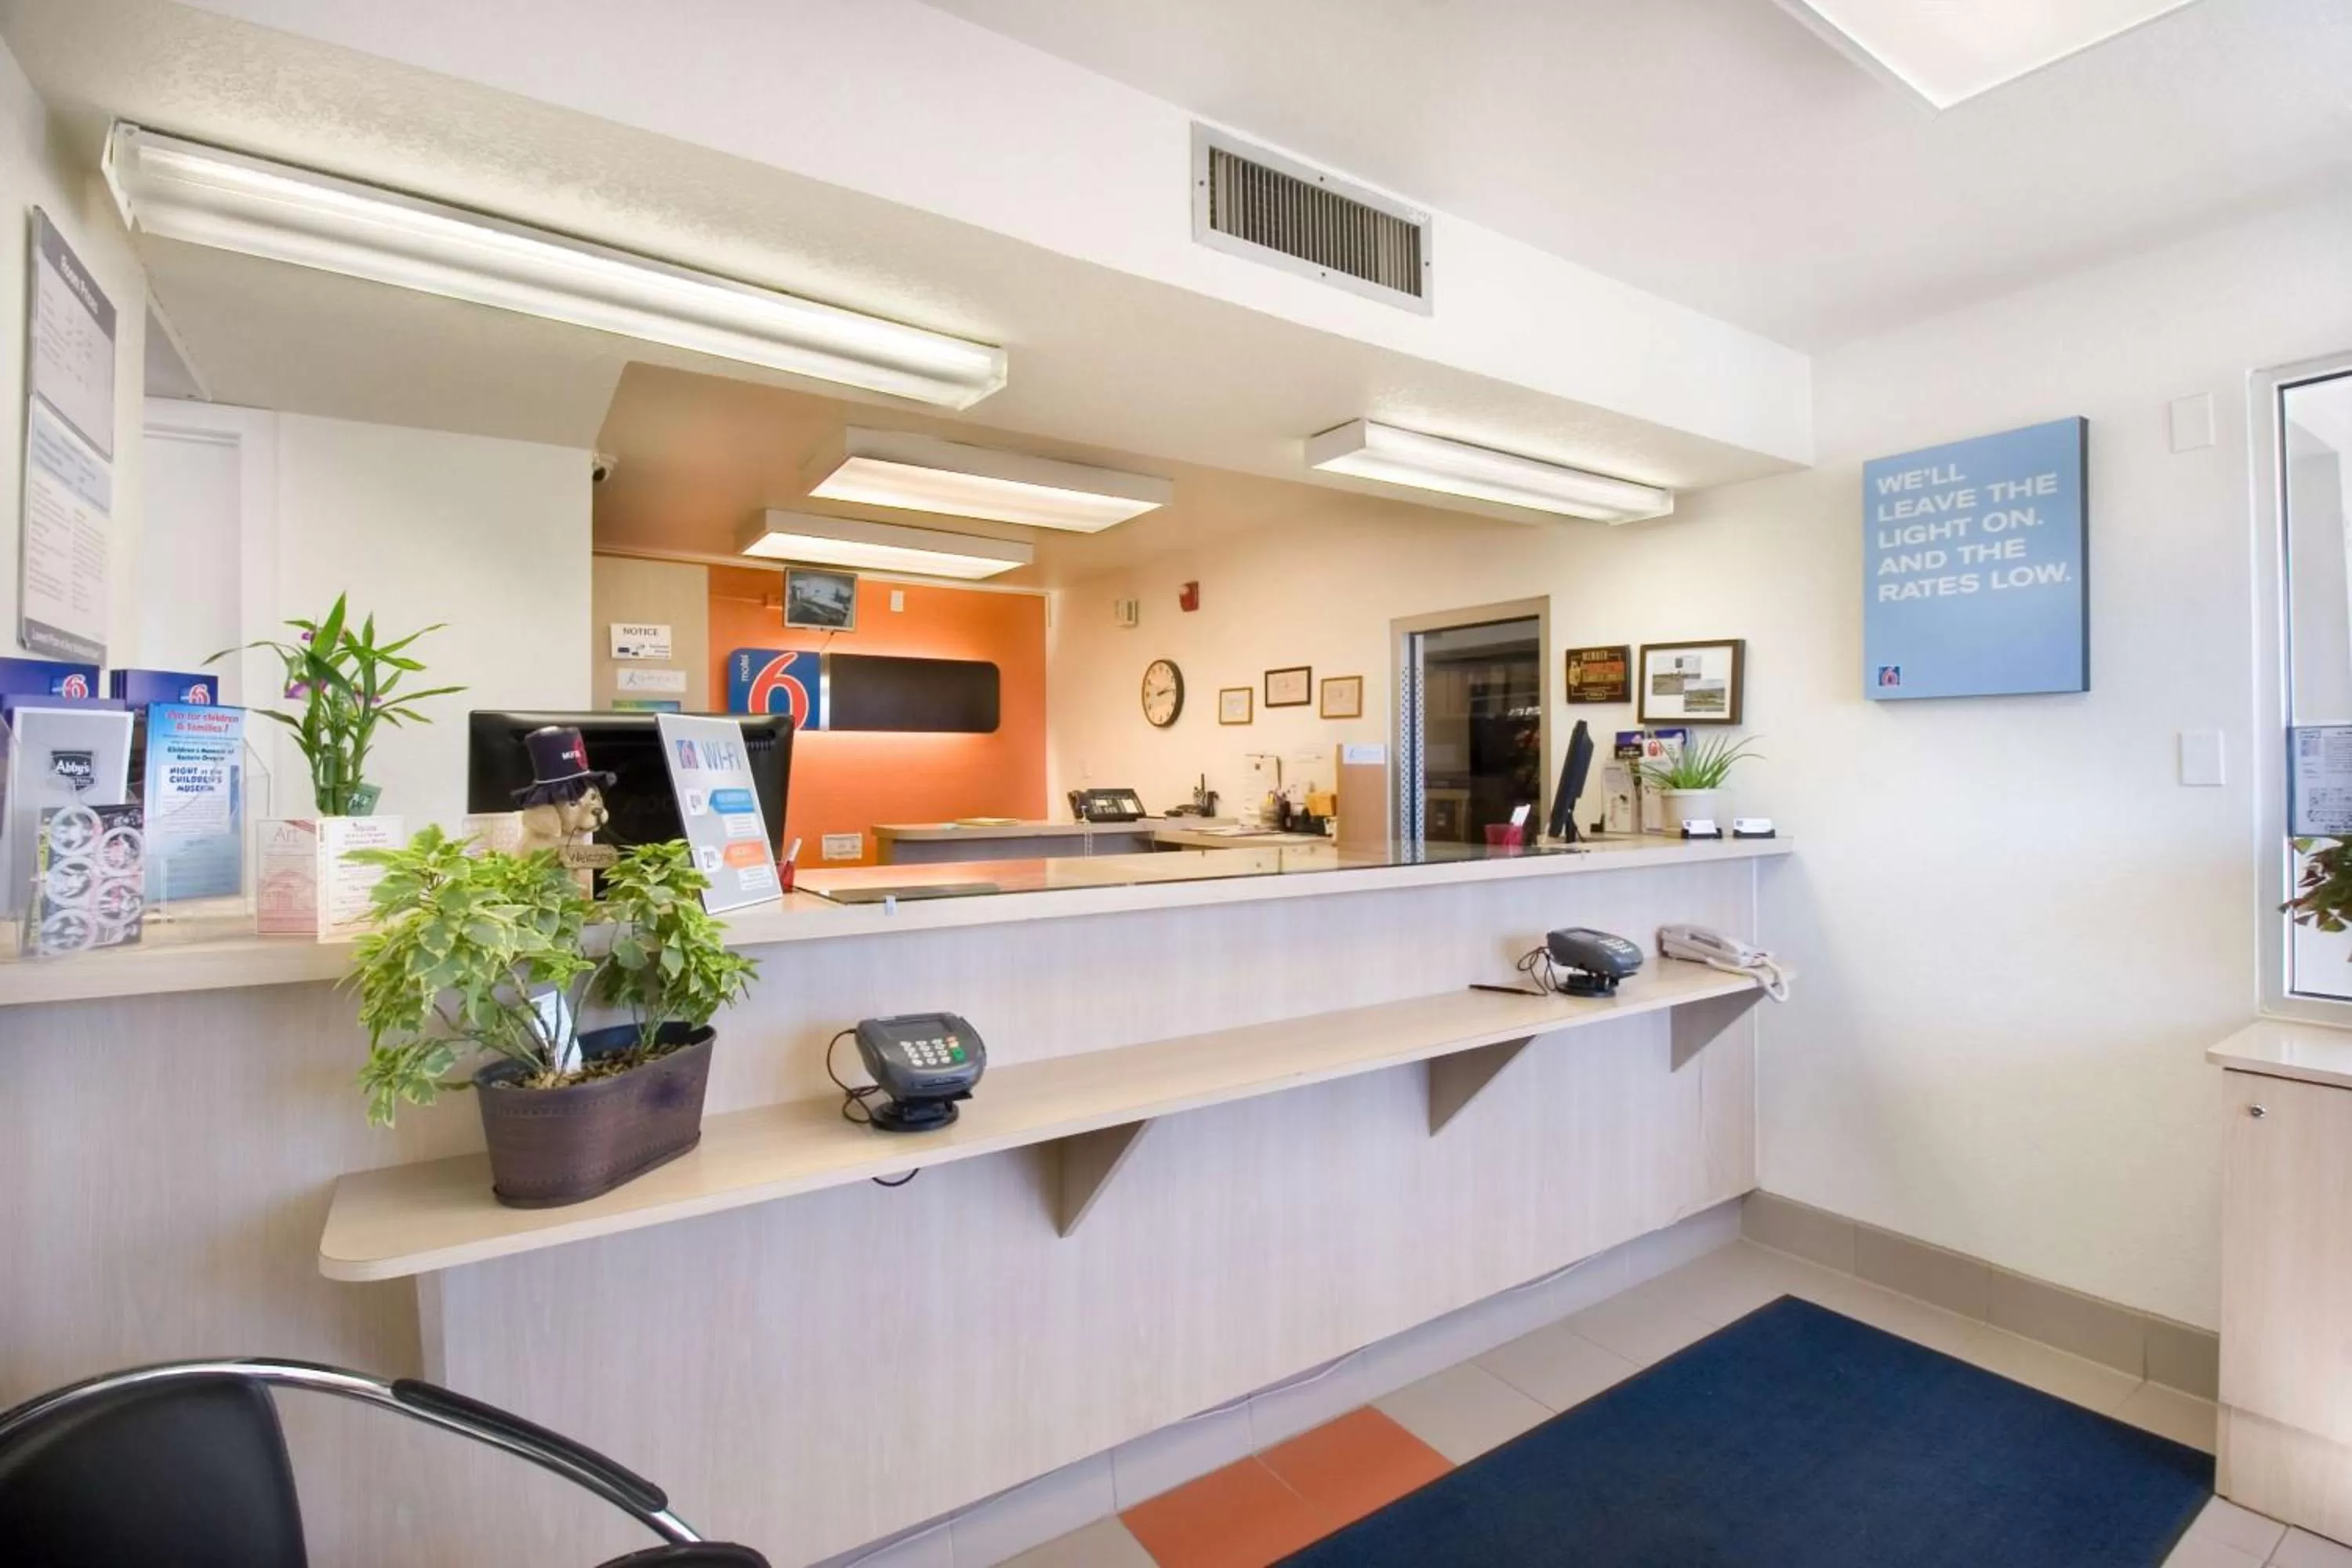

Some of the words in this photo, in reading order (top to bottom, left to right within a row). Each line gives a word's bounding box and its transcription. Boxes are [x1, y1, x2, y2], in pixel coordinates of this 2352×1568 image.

[1876, 463, 1966, 495] WE'LL
[1878, 488, 1976, 522] LEAVE
[1987, 473, 2058, 503] THE
[1878, 517, 1972, 549] LIGHT
[1982, 507, 2044, 533] ON.
[1877, 550, 1947, 575] AND
[1957, 537, 2027, 564] THE
[1878, 572, 1980, 602] RATES
[1991, 561, 2071, 591] LOW.
[622, 626, 658, 637] NOTICE
[63, 673, 89, 699] 6
[747, 652, 809, 729] 6
[202, 713, 239, 722] children
[56, 759, 90, 775] Abby's
